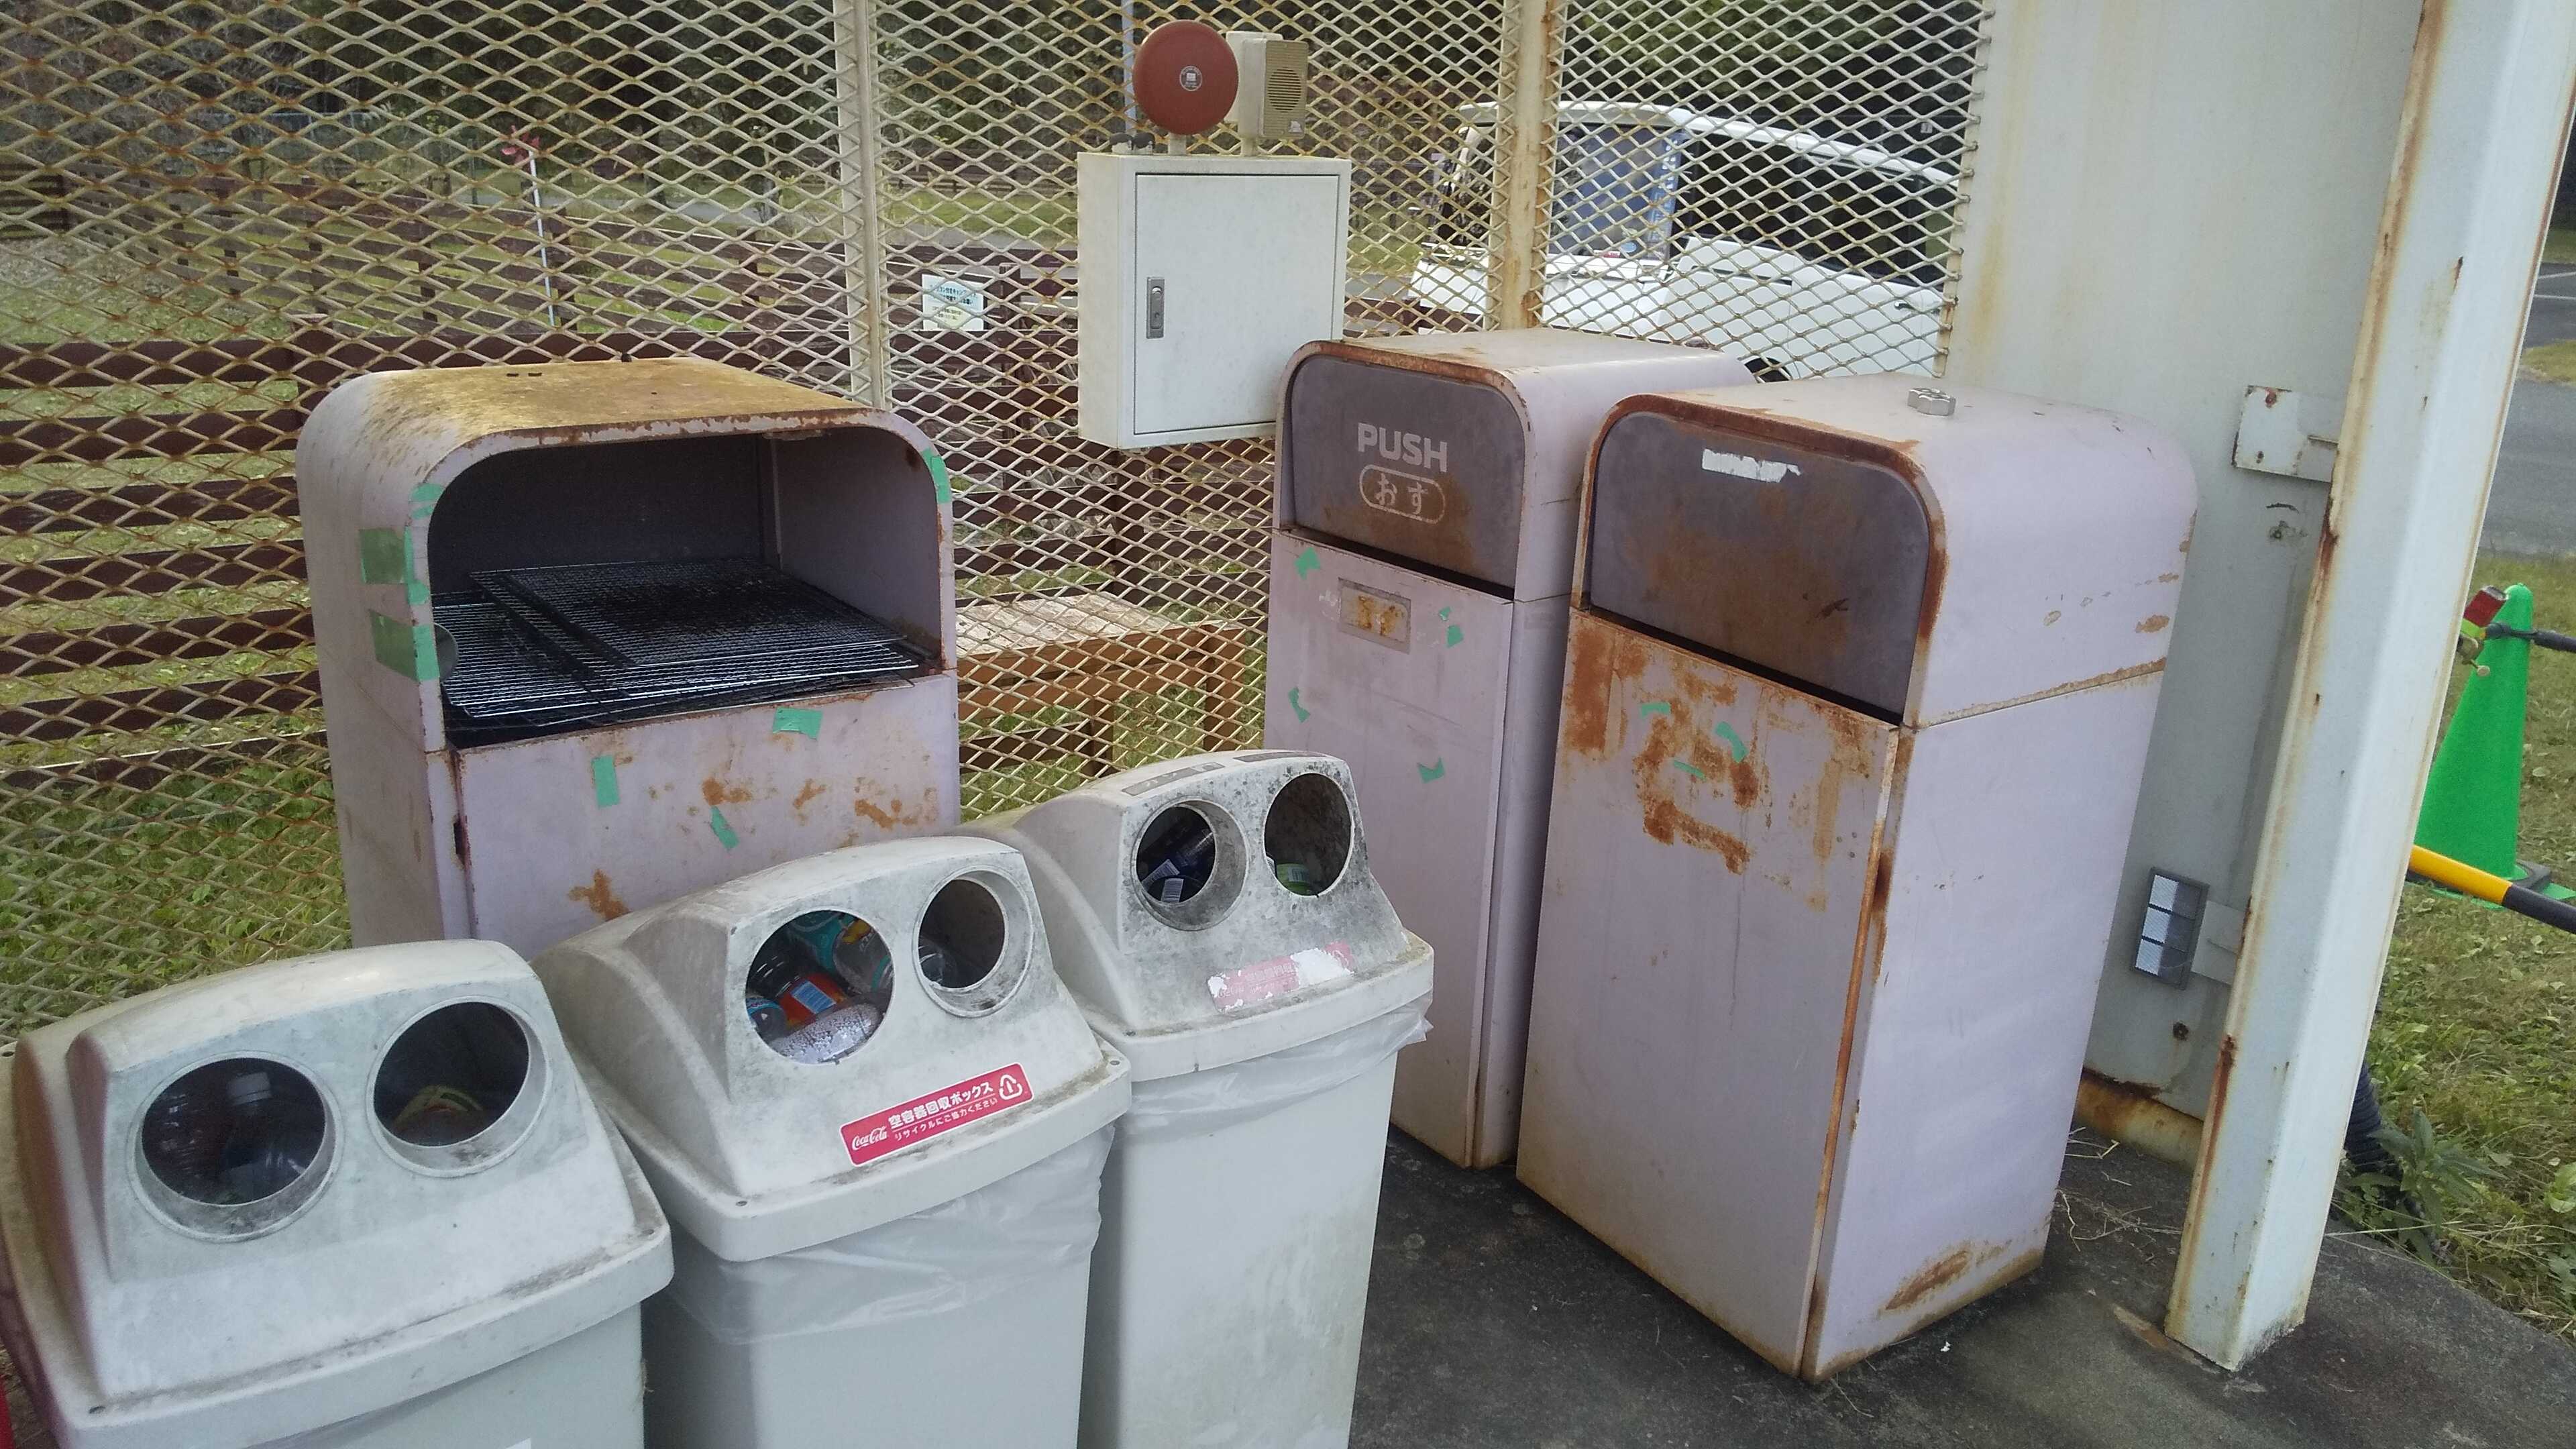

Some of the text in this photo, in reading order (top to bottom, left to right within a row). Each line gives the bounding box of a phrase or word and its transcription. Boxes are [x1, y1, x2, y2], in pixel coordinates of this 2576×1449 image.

[1358, 422, 1448, 473] PUSH
[1375, 473, 1429, 515] おす
[888, 1081, 994, 1130] 空容器回収ボックス
[895, 1097, 998, 1141] リサイクルにご協力ください
